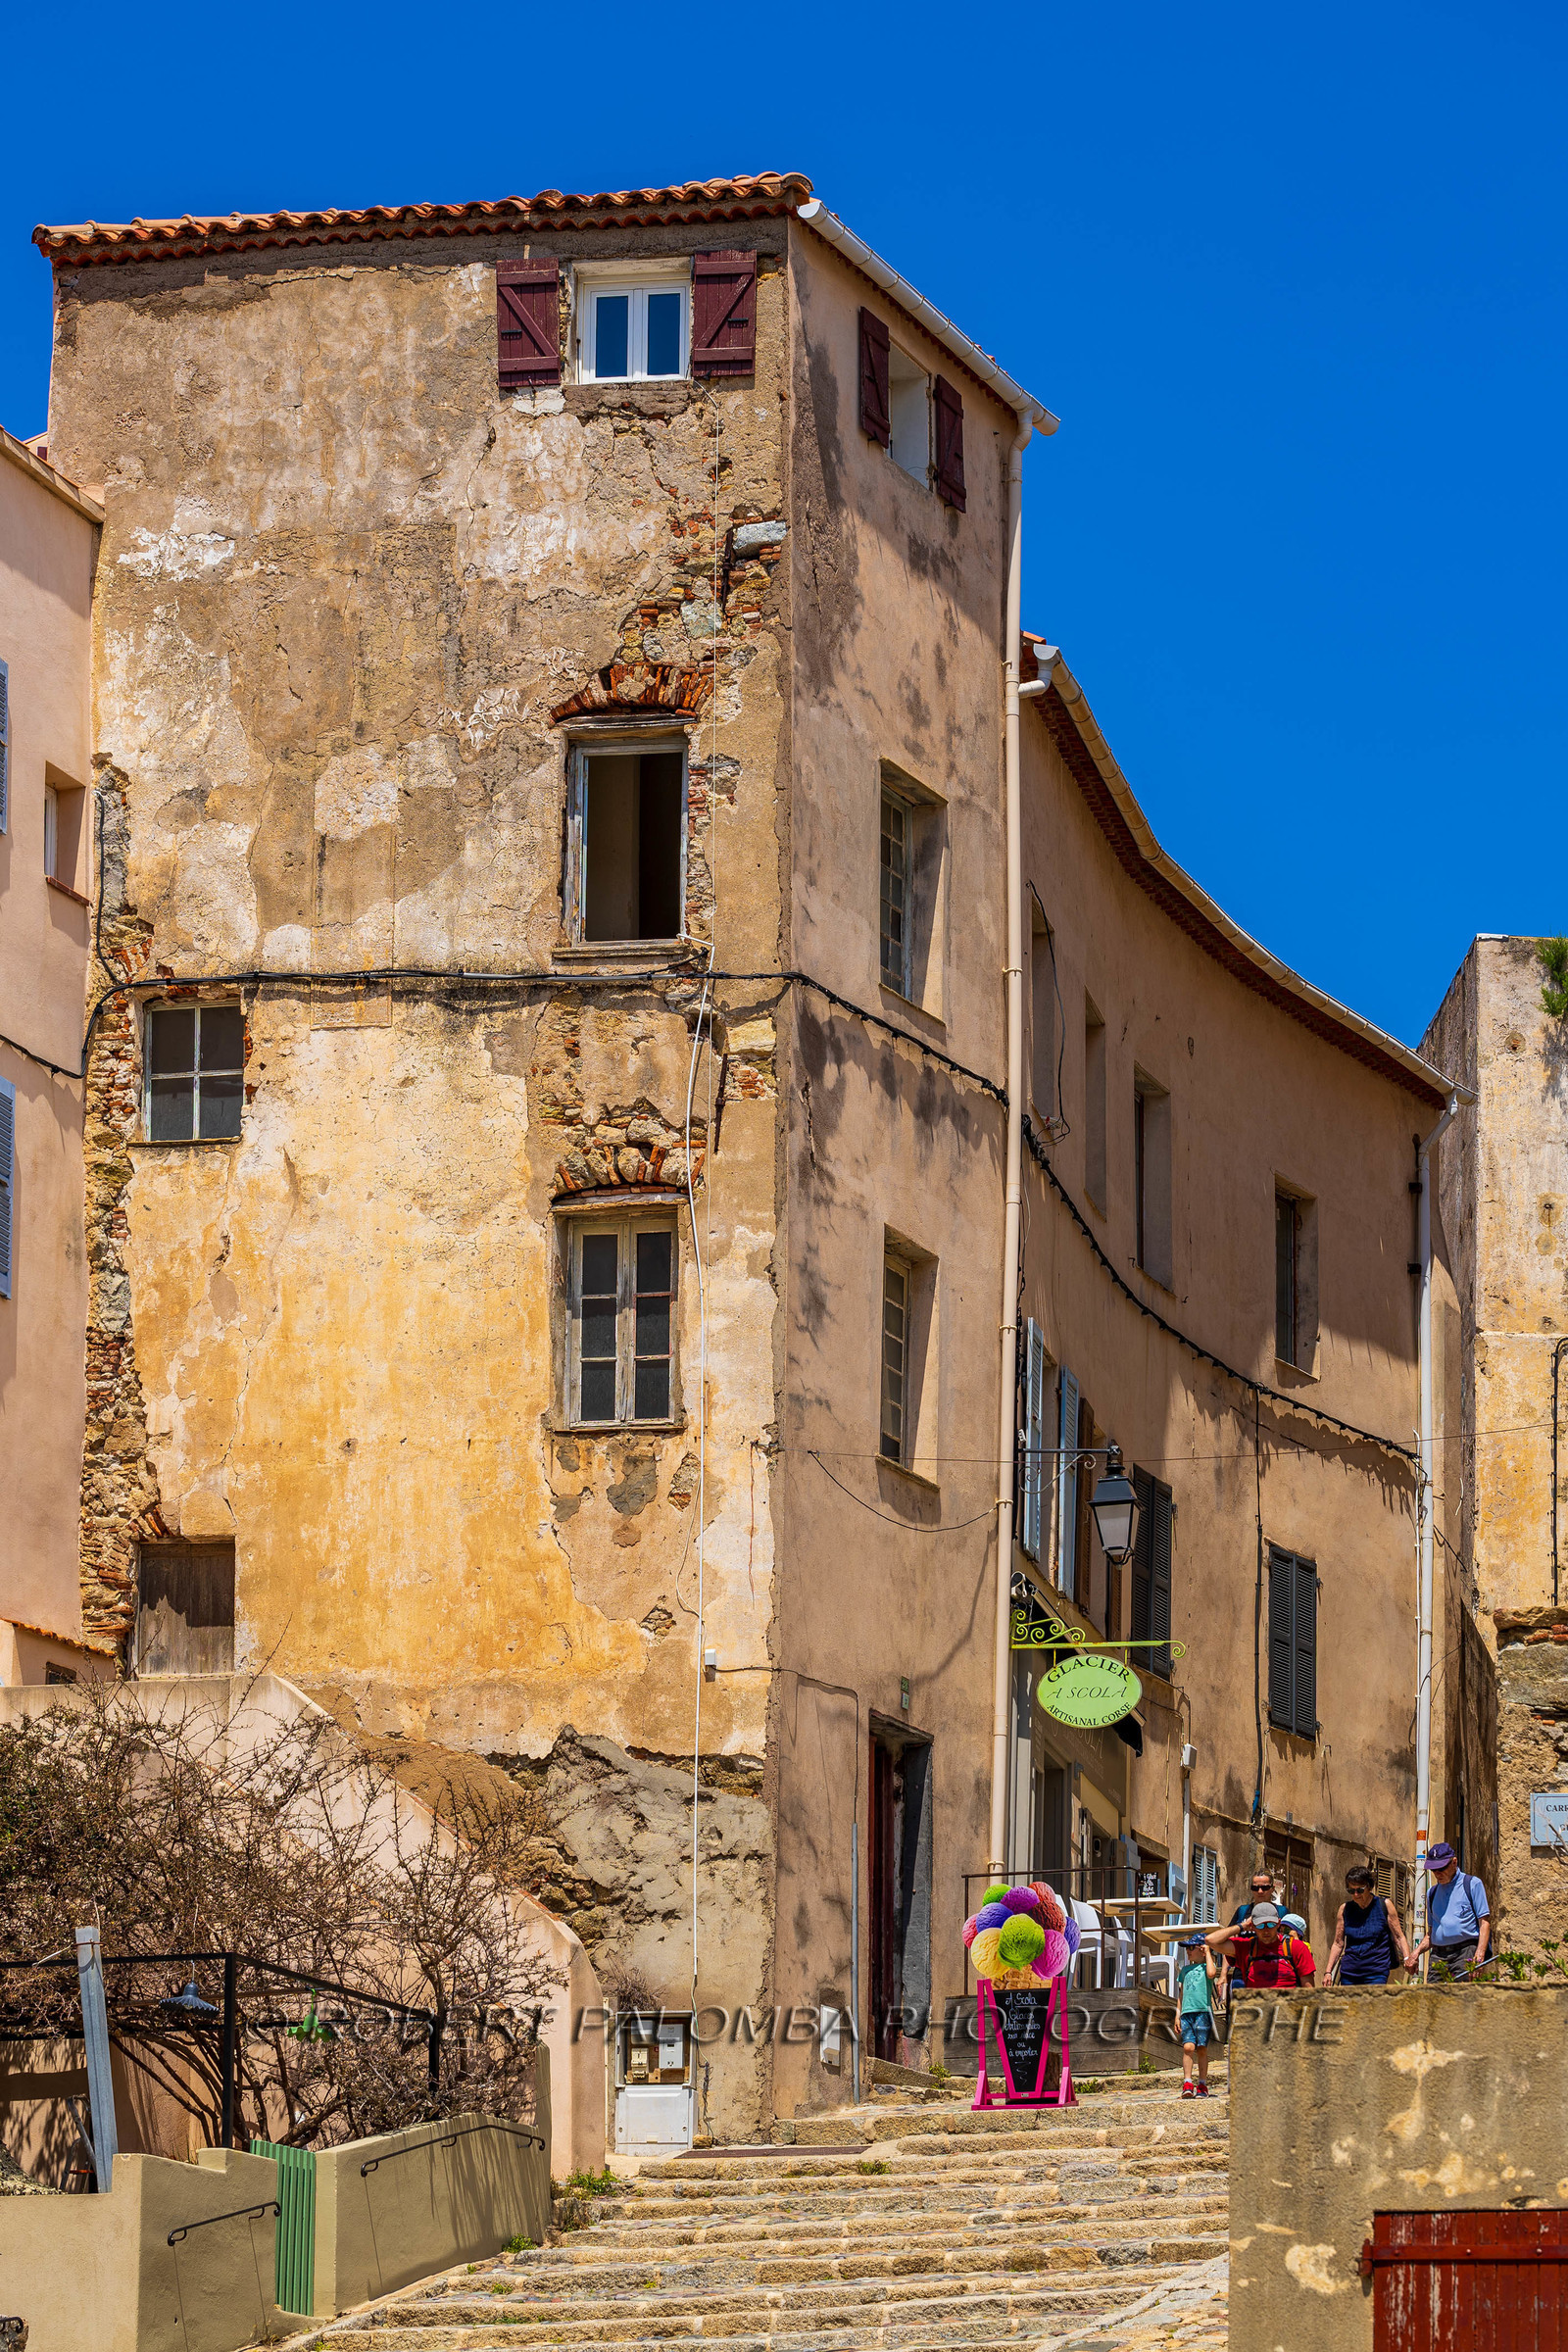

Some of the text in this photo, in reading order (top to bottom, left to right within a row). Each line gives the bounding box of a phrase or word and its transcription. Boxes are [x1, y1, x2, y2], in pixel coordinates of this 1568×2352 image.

[1047, 1655, 1130, 1683] GLACIER
[1047, 1686, 1127, 1699] A SCOLA
[1047, 1701, 1132, 1726] ARTISANAL CORSE
